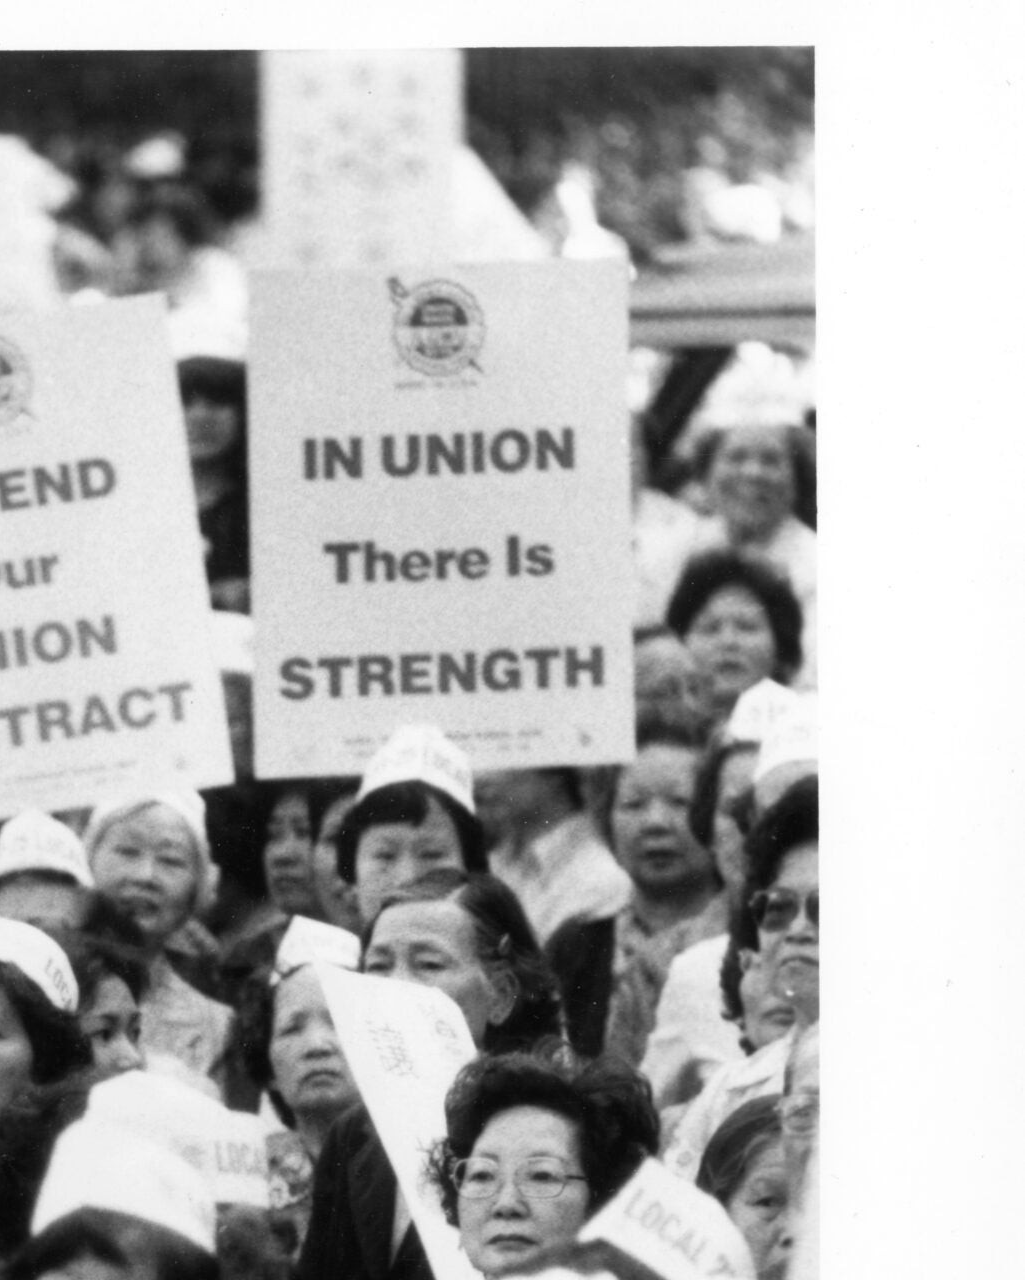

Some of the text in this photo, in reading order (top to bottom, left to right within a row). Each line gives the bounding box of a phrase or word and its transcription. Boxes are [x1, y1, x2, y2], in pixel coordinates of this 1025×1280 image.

[303, 427, 576, 481] IN UNION
[323, 534, 554, 585] There Is
[279, 644, 604, 701] STRENGTH
[623, 1187, 710, 1268] LOCAL
